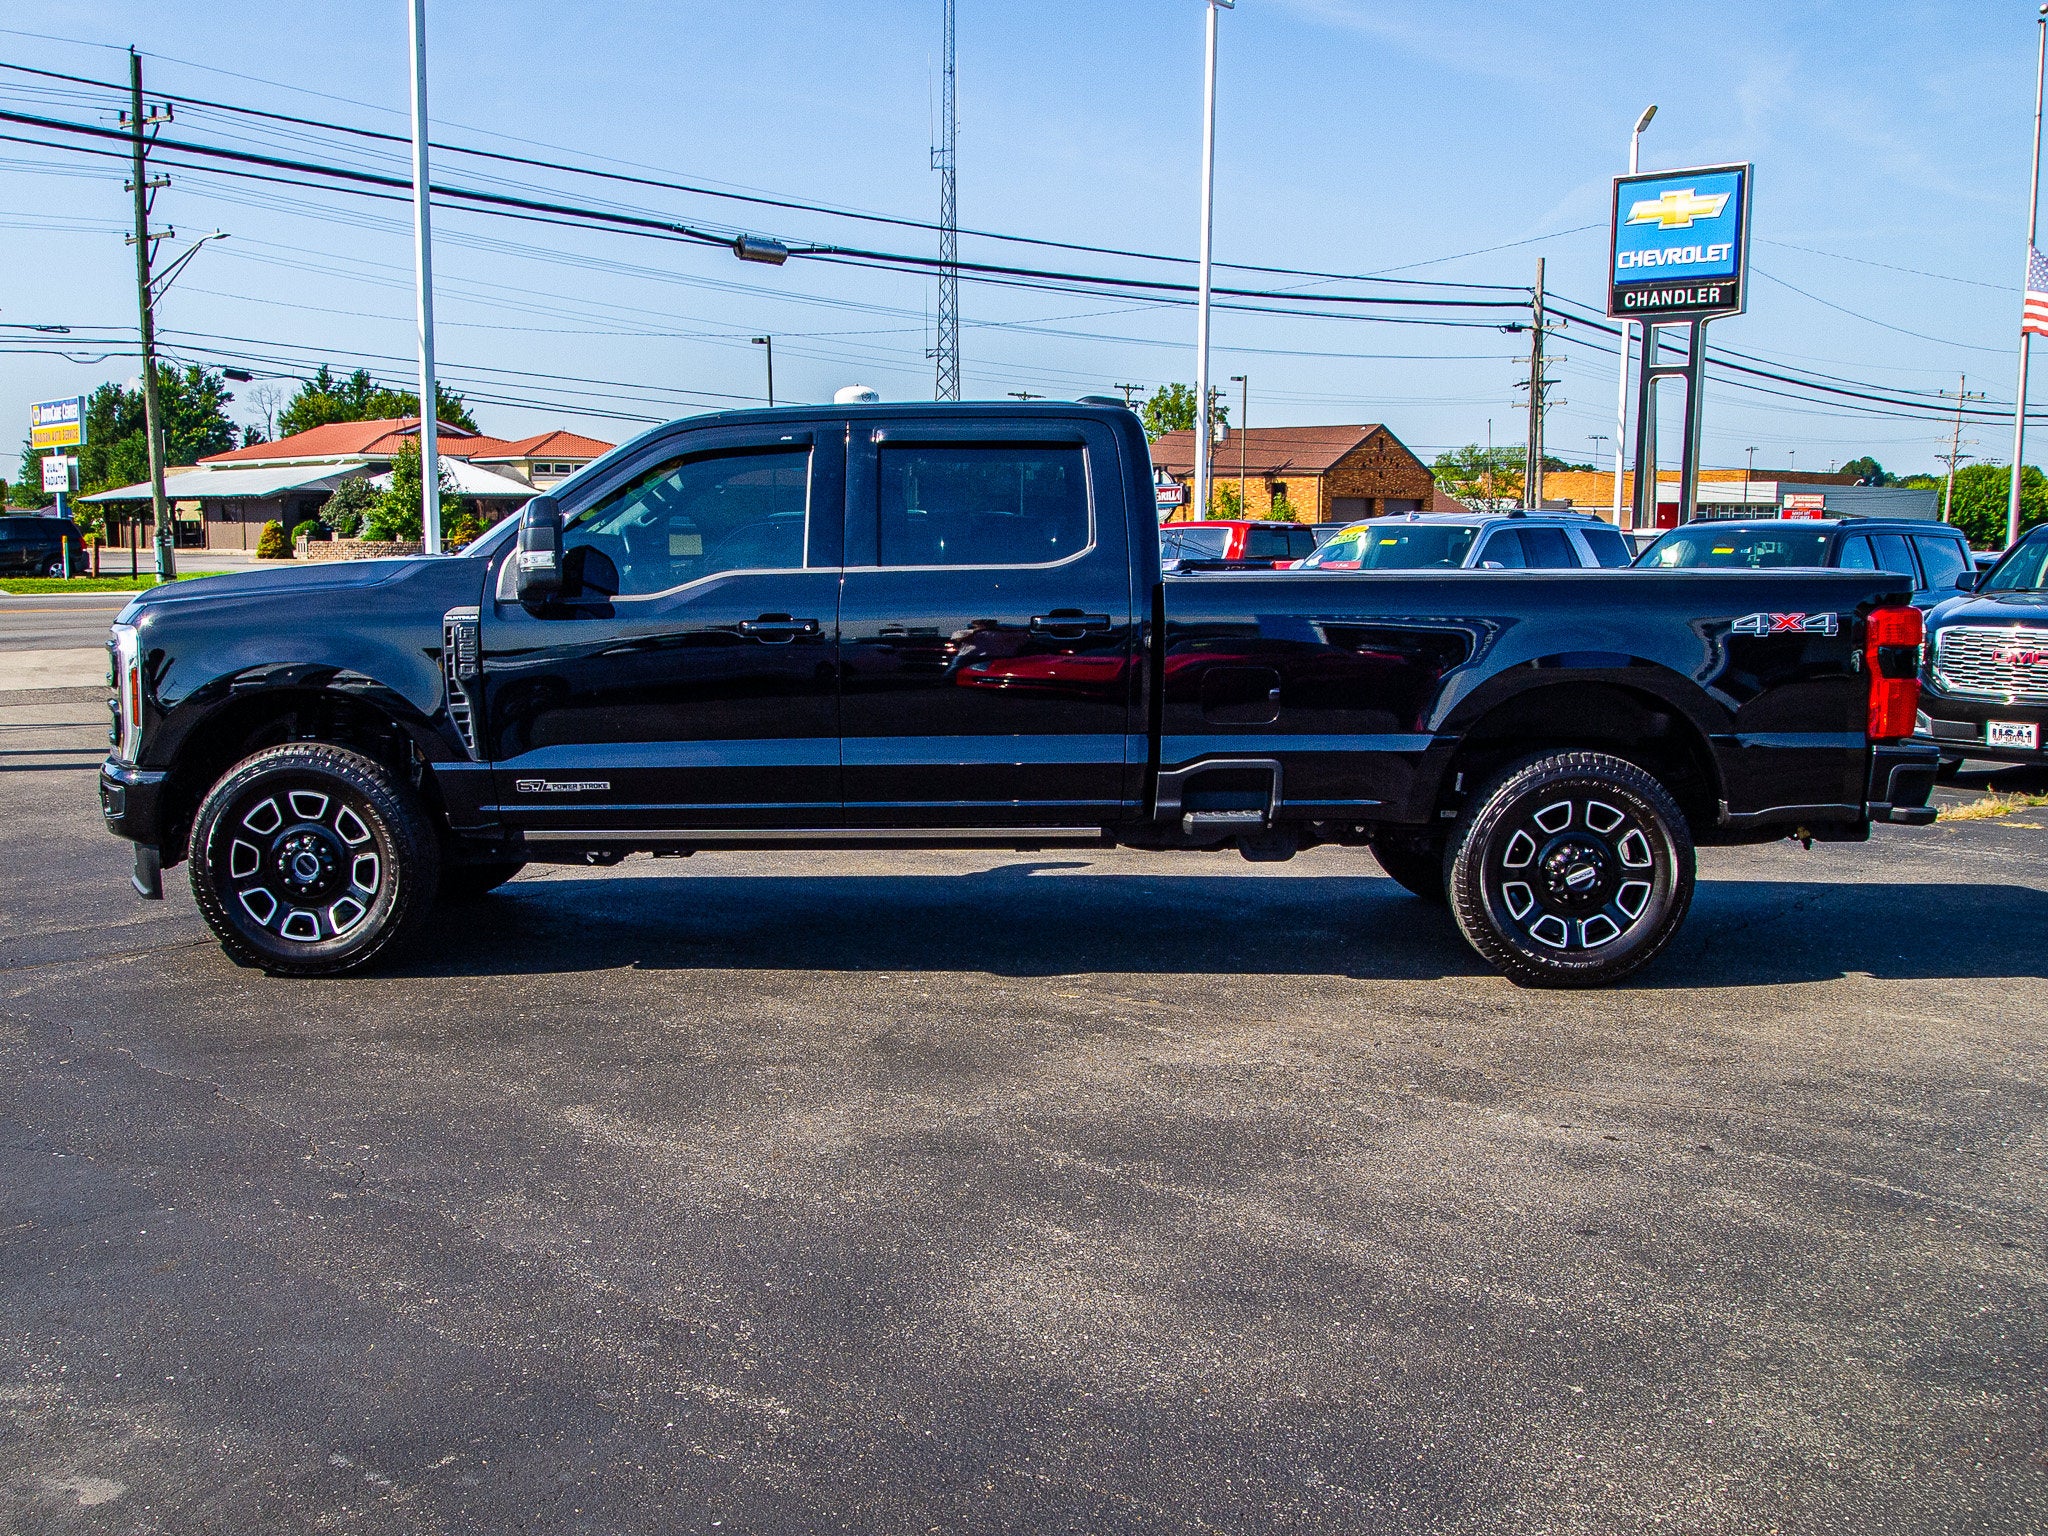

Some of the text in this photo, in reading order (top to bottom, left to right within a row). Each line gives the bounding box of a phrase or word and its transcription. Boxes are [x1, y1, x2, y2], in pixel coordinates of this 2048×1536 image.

[1617, 243, 1733, 269] CHEVROLET
[1624, 287, 1721, 308] CHANDLER
[1992, 649, 2048, 665] GMC
[552, 783, 578, 791] POWER
[580, 782, 609, 790] STROKE
